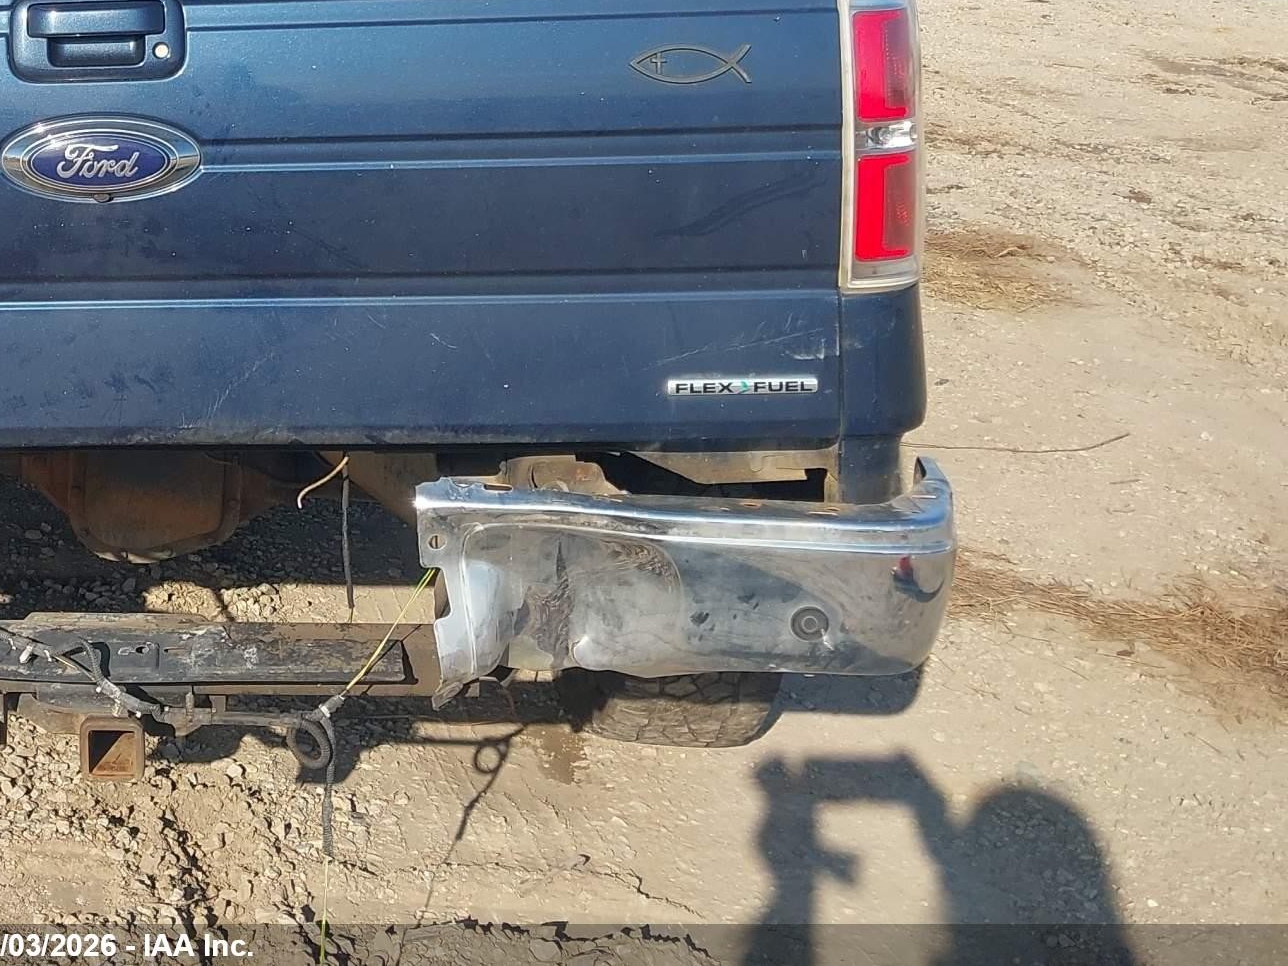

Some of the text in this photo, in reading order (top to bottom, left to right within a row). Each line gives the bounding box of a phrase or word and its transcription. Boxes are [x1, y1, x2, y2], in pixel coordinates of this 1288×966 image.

[56, 143, 140, 179] Ford
[675, 381, 813, 394] FLEX FUEL
